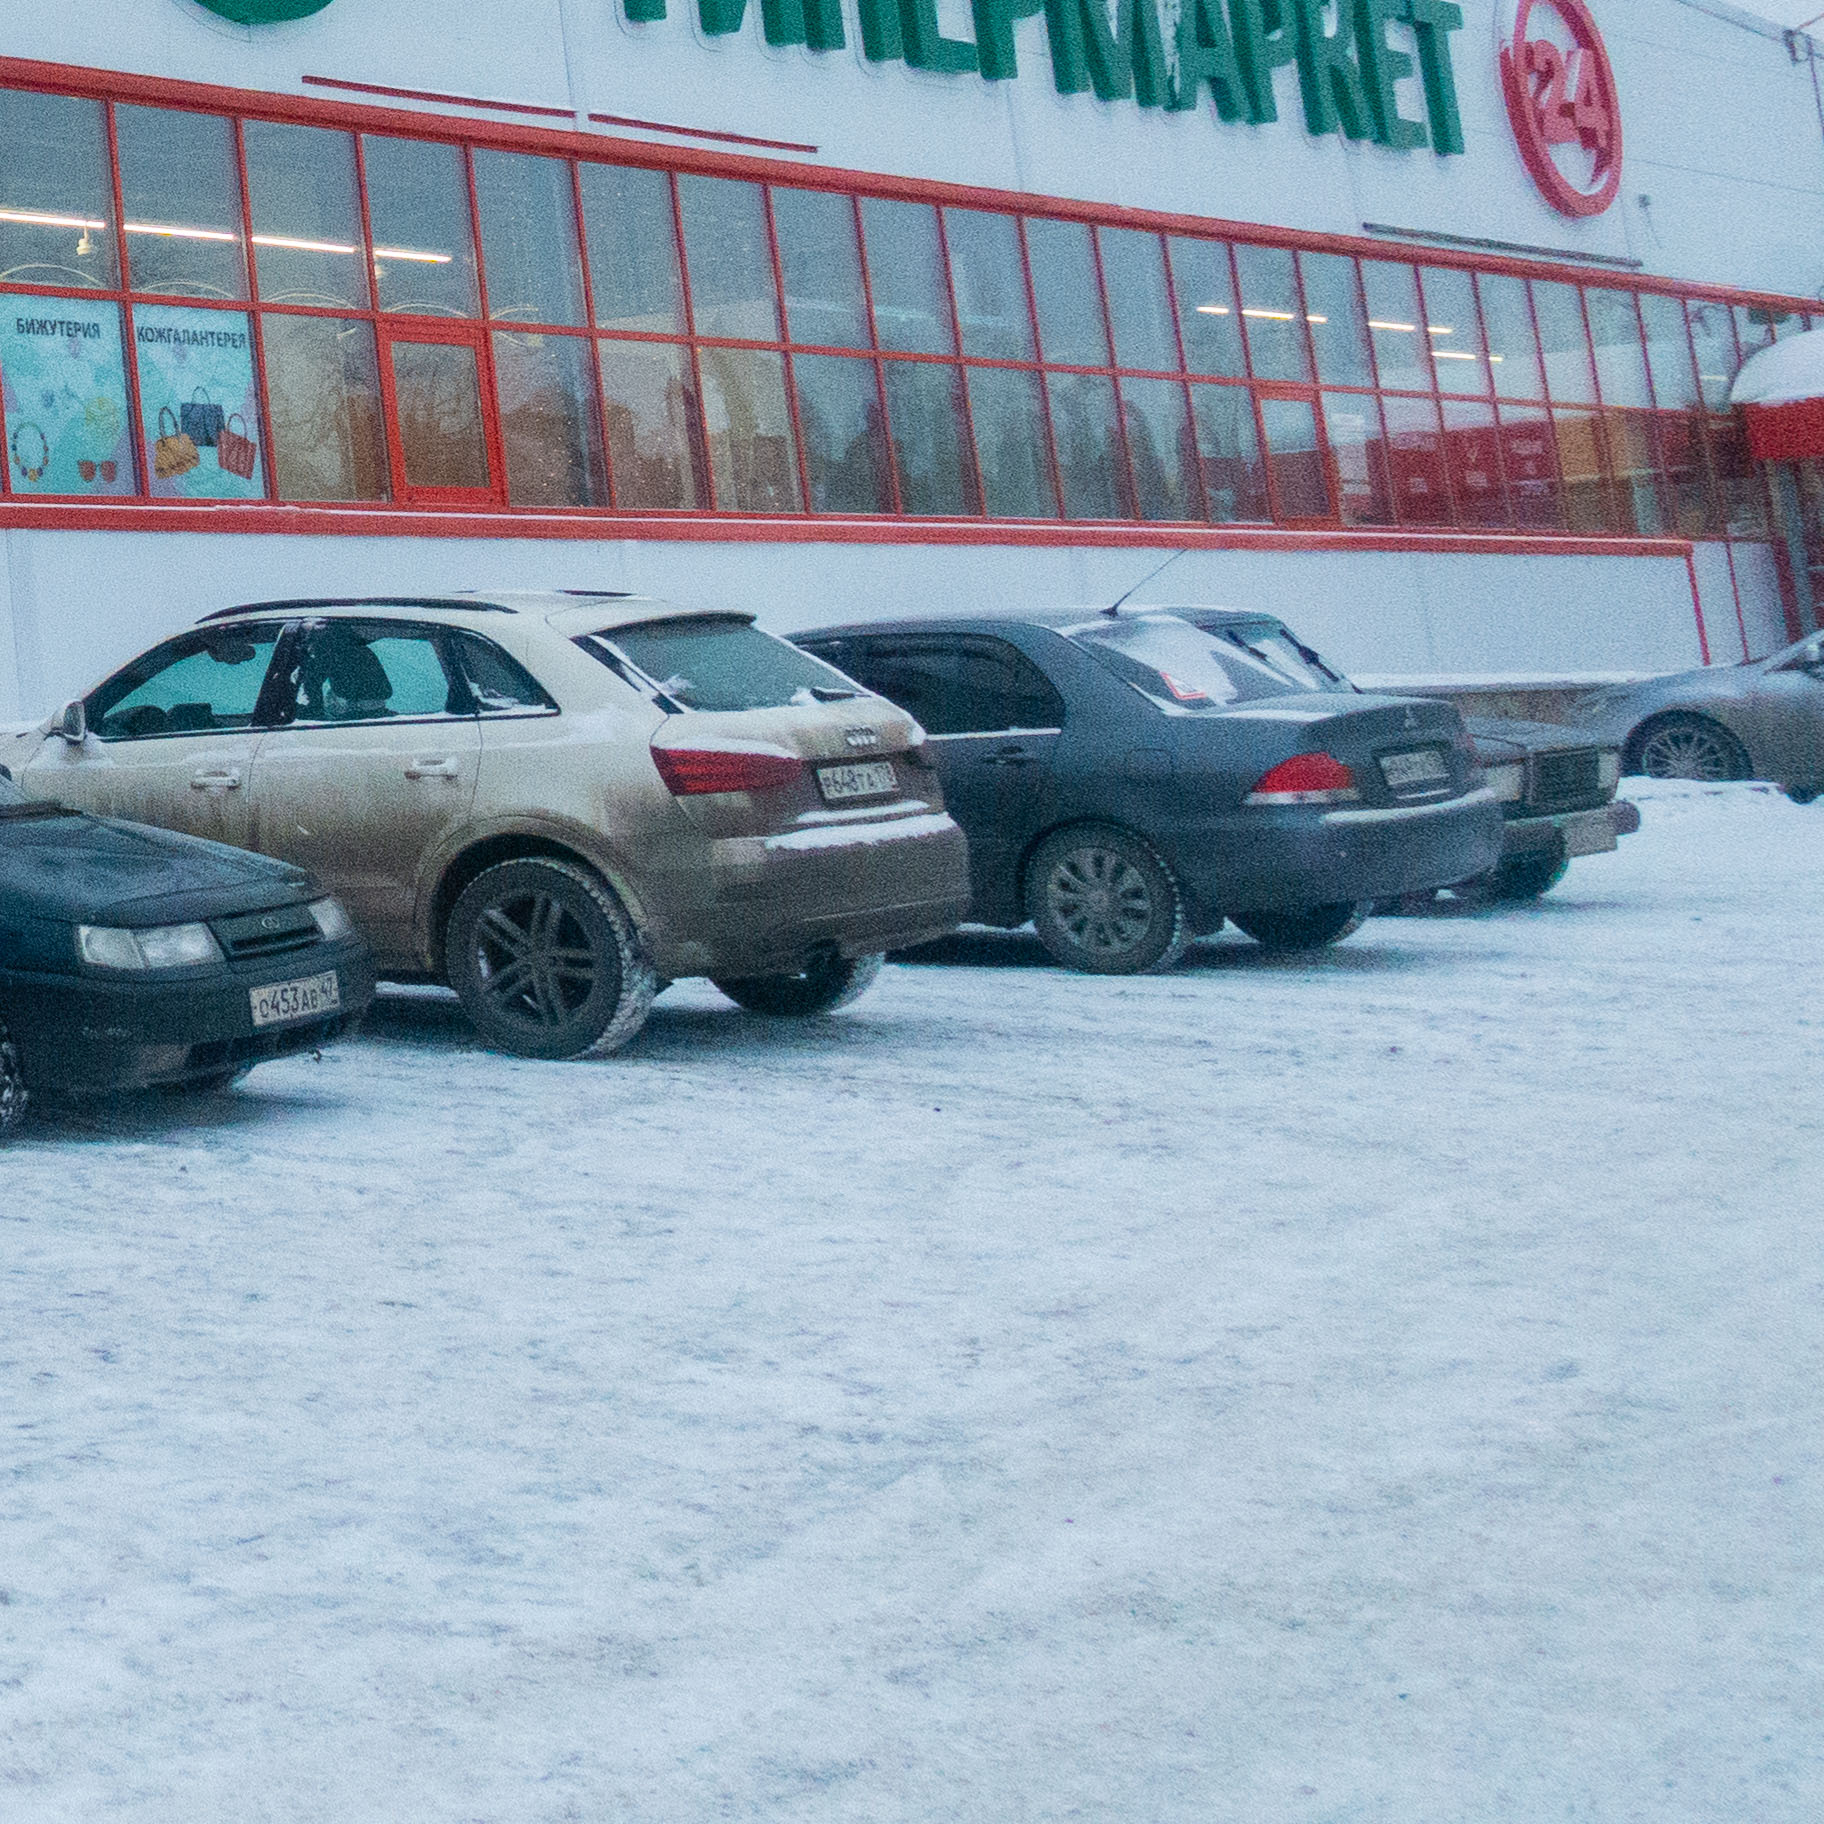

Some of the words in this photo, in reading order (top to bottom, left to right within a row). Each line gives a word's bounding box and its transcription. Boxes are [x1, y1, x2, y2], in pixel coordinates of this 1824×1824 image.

[1523, 38, 1610, 150] 24
[16, 318, 101, 339] БИЖУТЕРИЯ
[137, 326, 246, 349] КОЖГАЛАНТЕРЕЯ
